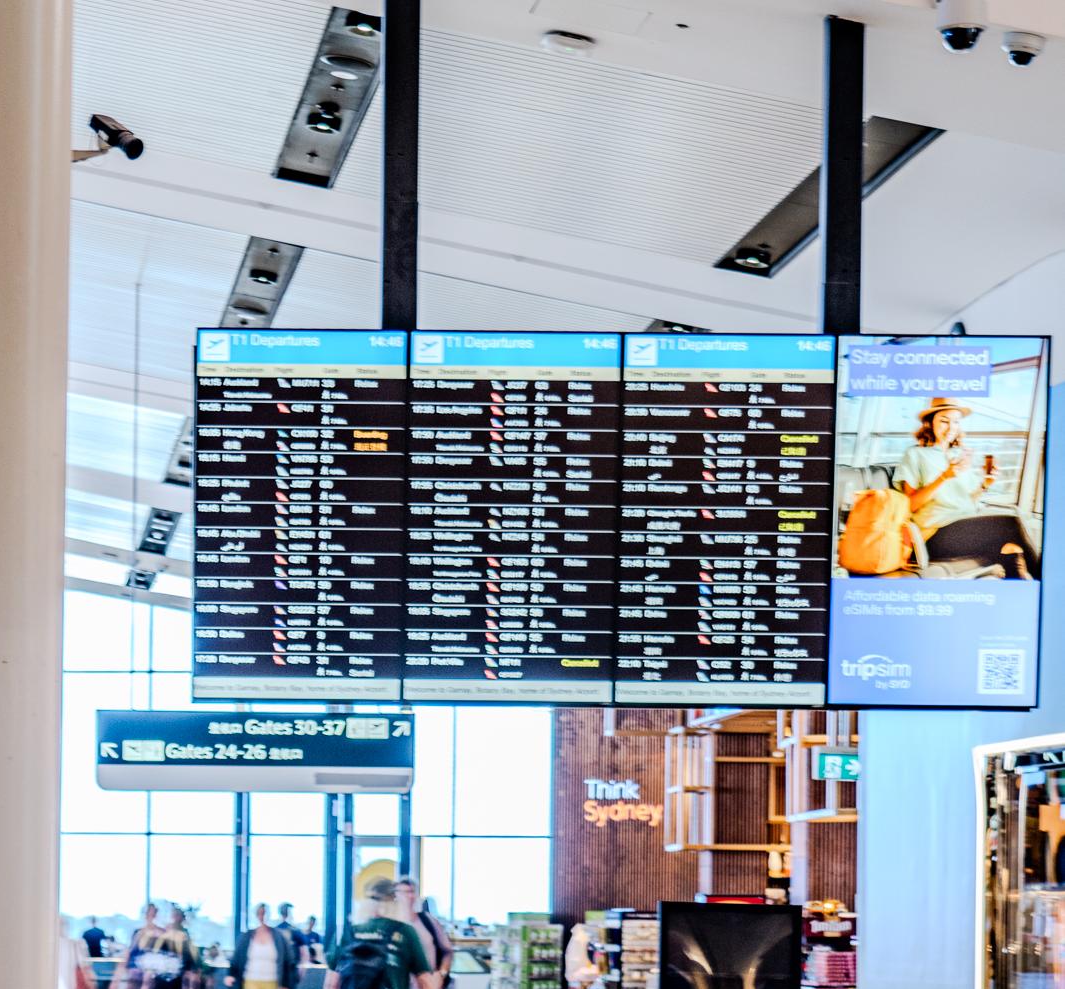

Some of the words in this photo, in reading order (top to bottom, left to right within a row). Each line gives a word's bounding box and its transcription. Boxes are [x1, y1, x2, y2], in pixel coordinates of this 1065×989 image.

[231, 334, 247, 347] T1
[250, 335, 320, 348] Departures
[446, 336, 461, 348] T1
[465, 336, 534, 350] Departures
[659, 338, 676, 350] T1
[678, 338, 748, 351] Departures
[851, 349, 891, 368] Stay
[894, 350, 990, 366] connected
[851, 374, 898, 391] while
[902, 378, 934, 394] you
[937, 376, 987, 392] travel
[841, 658, 912, 680] tripsim
[245, 718, 294, 735] Gates
[294, 720, 346, 736] 30-37
[165, 743, 214, 759] Gates
[214, 743, 267, 760] 24-26
[584, 779, 640, 800] Think
[584, 800, 664, 826] Sydney
